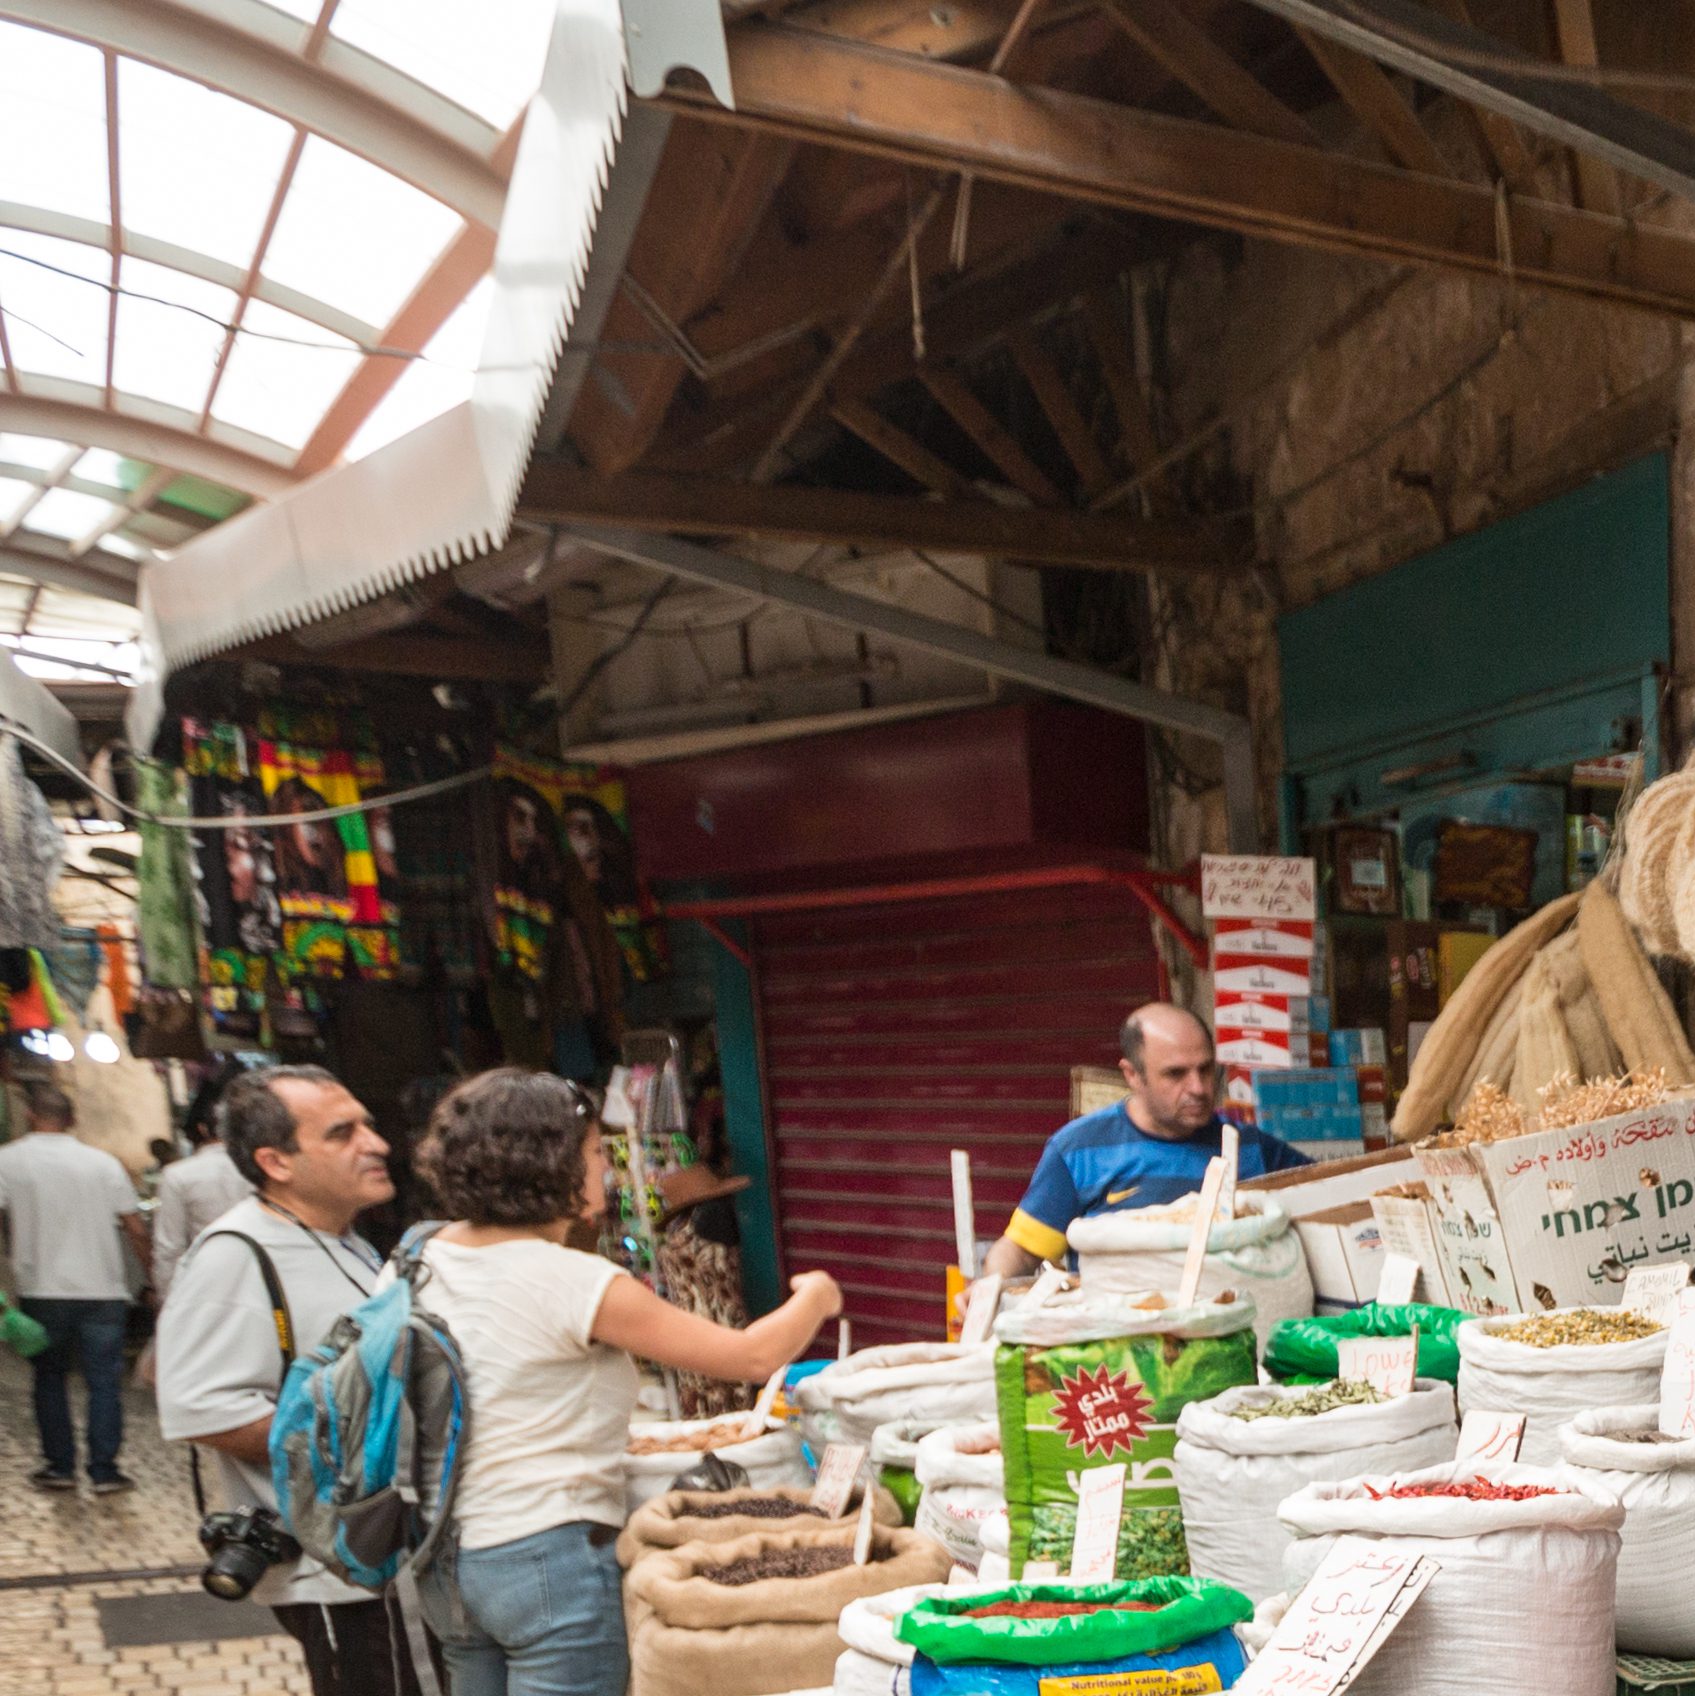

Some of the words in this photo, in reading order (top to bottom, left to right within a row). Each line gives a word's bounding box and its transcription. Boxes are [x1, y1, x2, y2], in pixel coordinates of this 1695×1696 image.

[1542, 1191, 1642, 1239] צמחי
[1077, 1382, 1119, 1415] بلدي
[1083, 1409, 1131, 1445] ممتاز
[1071, 1678, 1131, 1691] Nutritional
[1134, 1674, 1164, 1686] value
